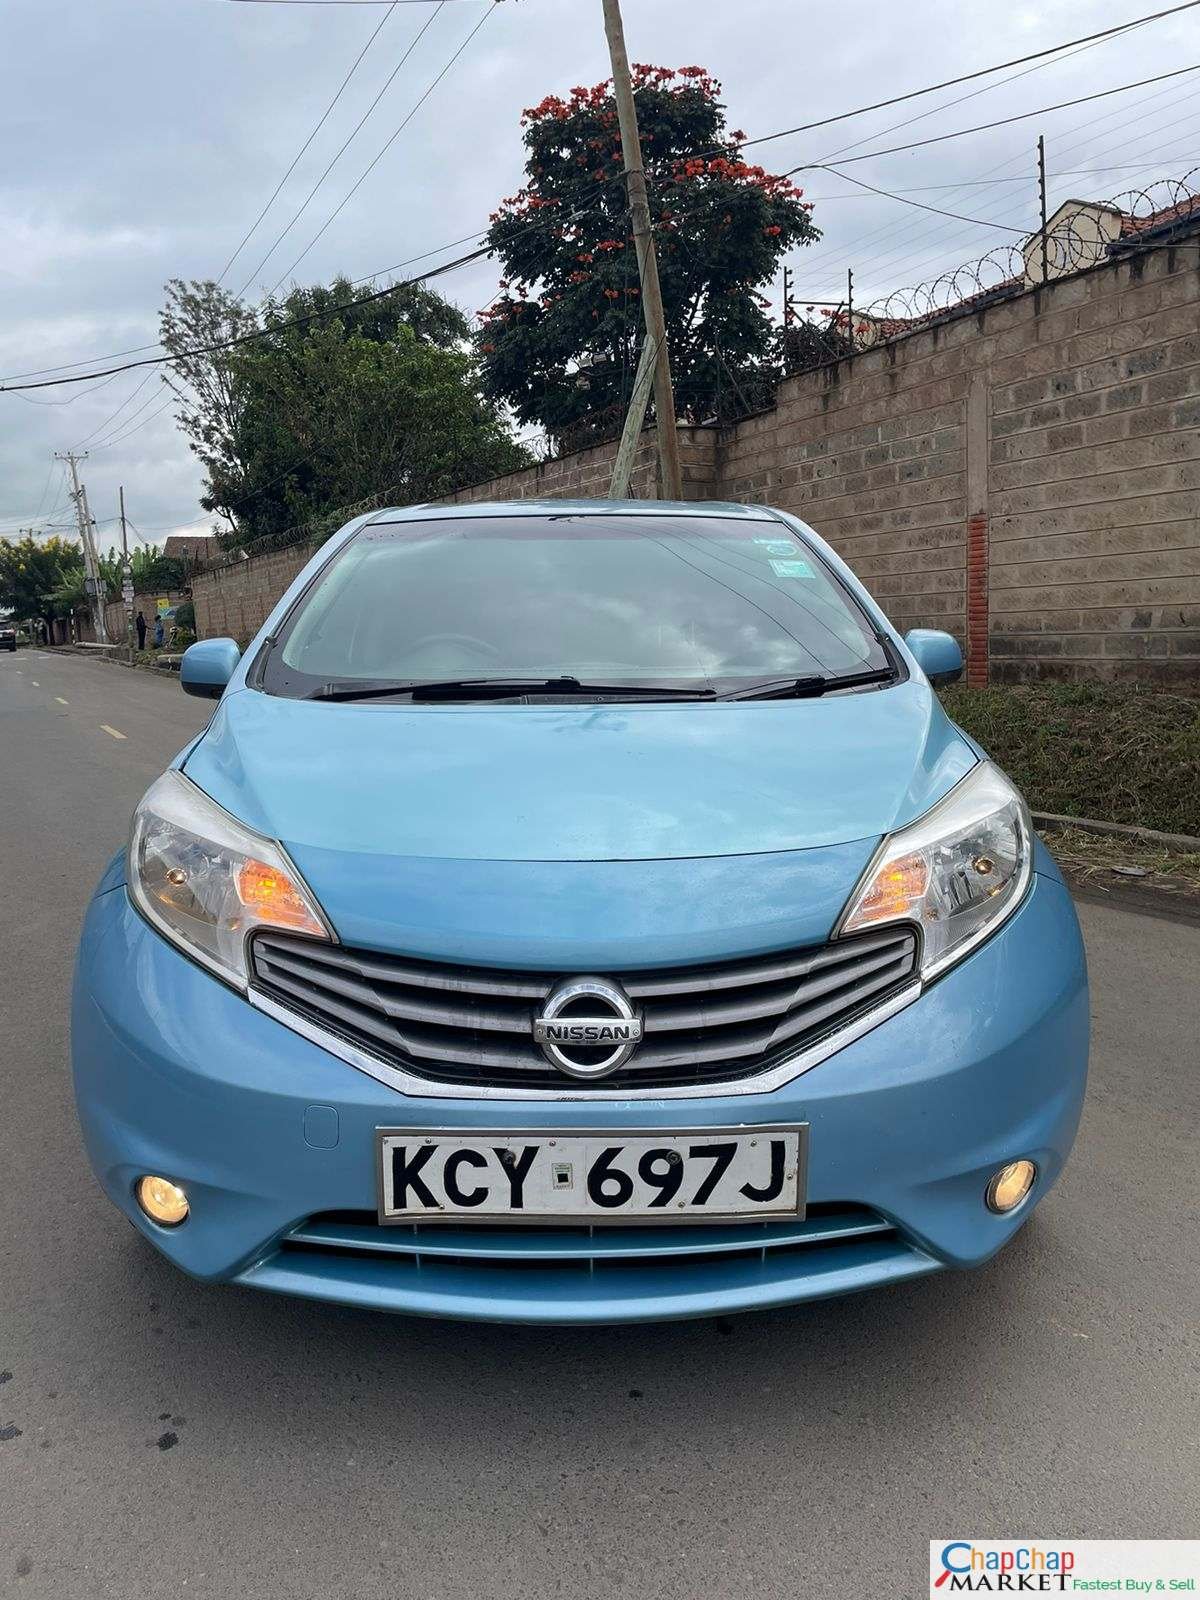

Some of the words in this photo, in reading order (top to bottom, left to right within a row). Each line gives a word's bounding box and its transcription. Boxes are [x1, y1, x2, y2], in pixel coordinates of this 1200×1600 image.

[546, 1026, 630, 1040] NISSAN
[392, 1144, 539, 1209] KCY
[587, 1140, 786, 1208] 697J
